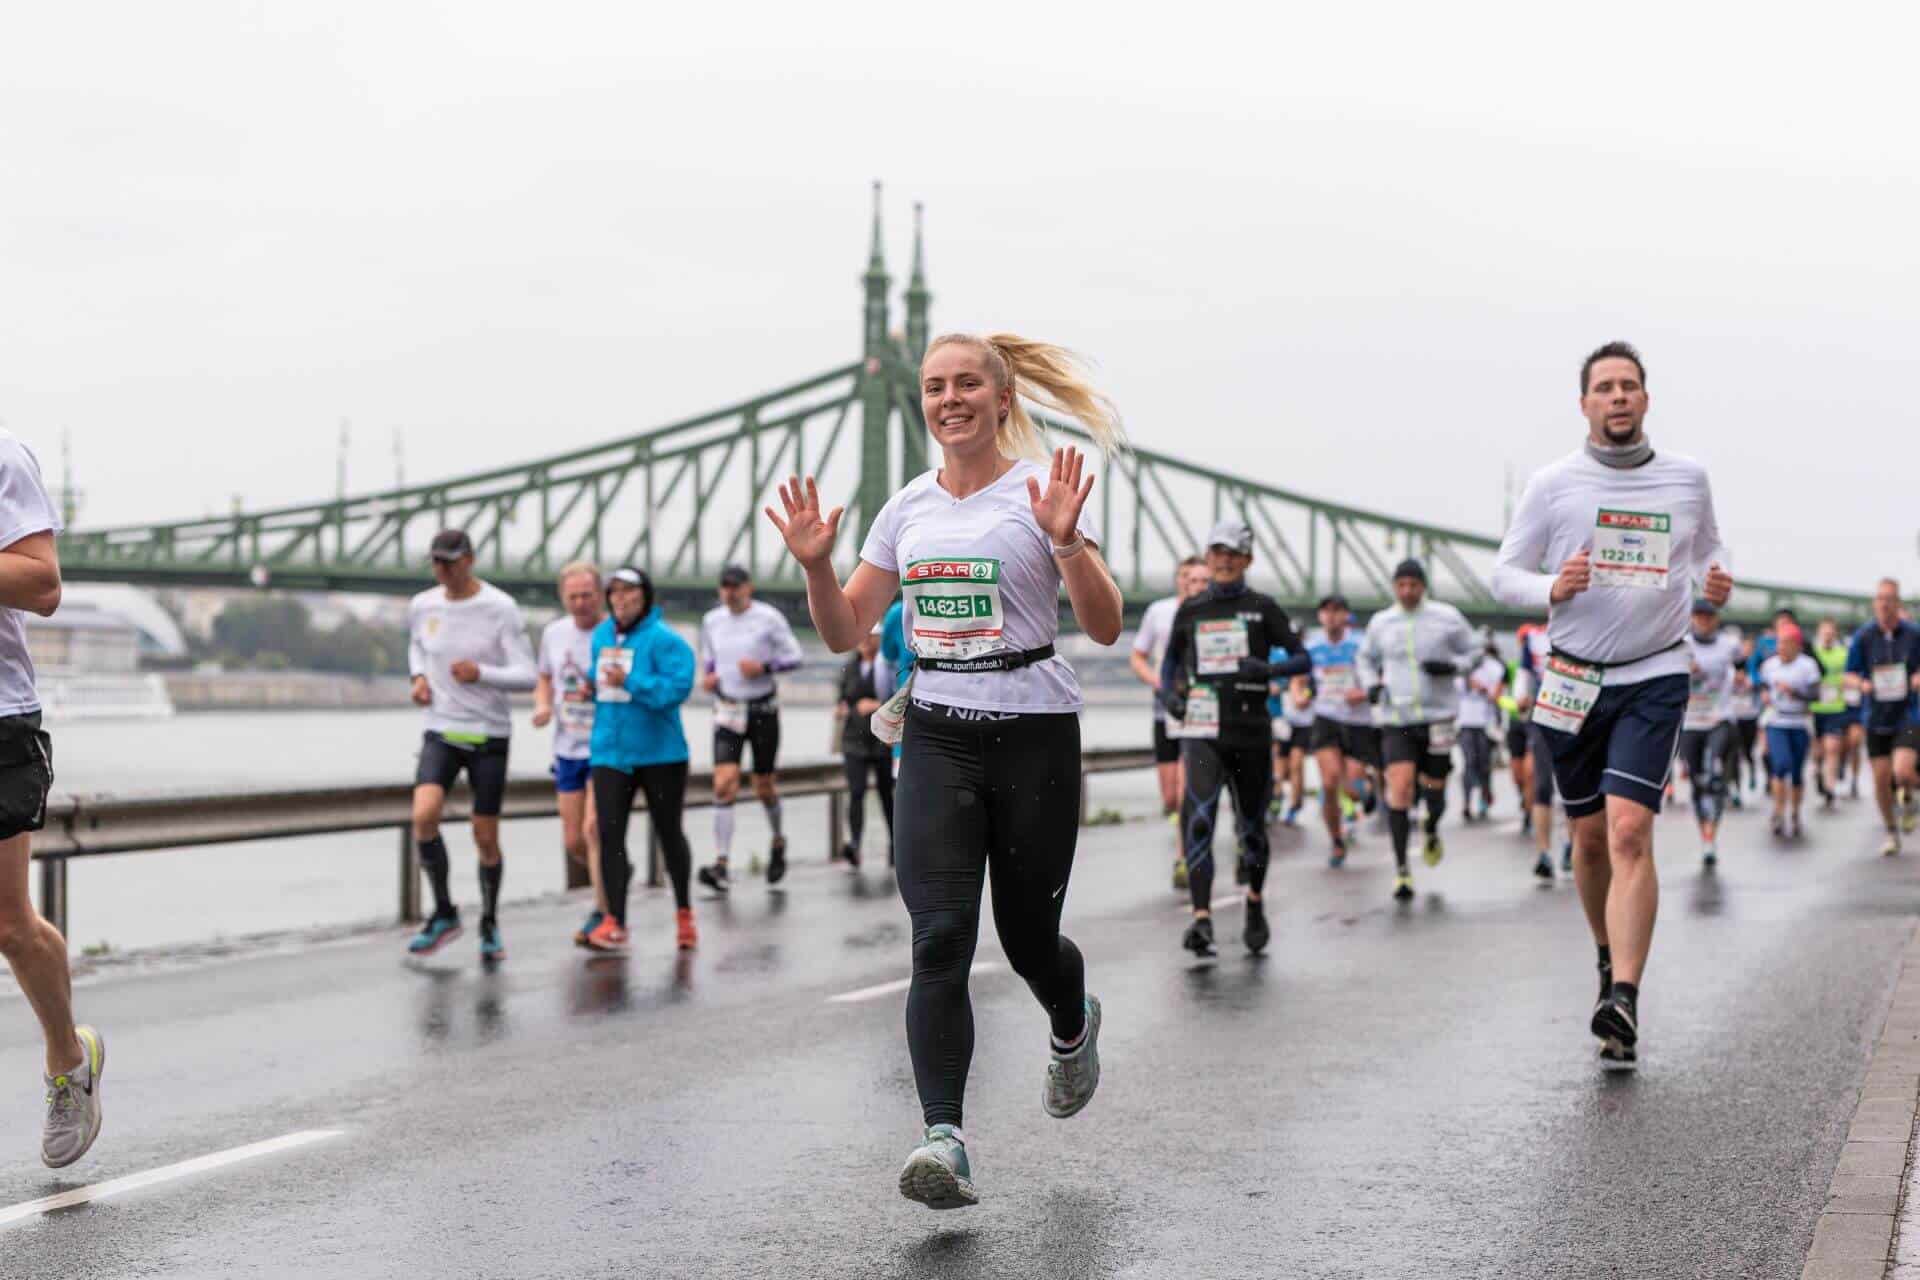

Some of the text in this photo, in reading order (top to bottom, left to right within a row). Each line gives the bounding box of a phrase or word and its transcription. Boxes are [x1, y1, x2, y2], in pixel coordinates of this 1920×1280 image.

[917, 563, 969, 577] SPAR
[919, 599, 987, 616] 14625 1
